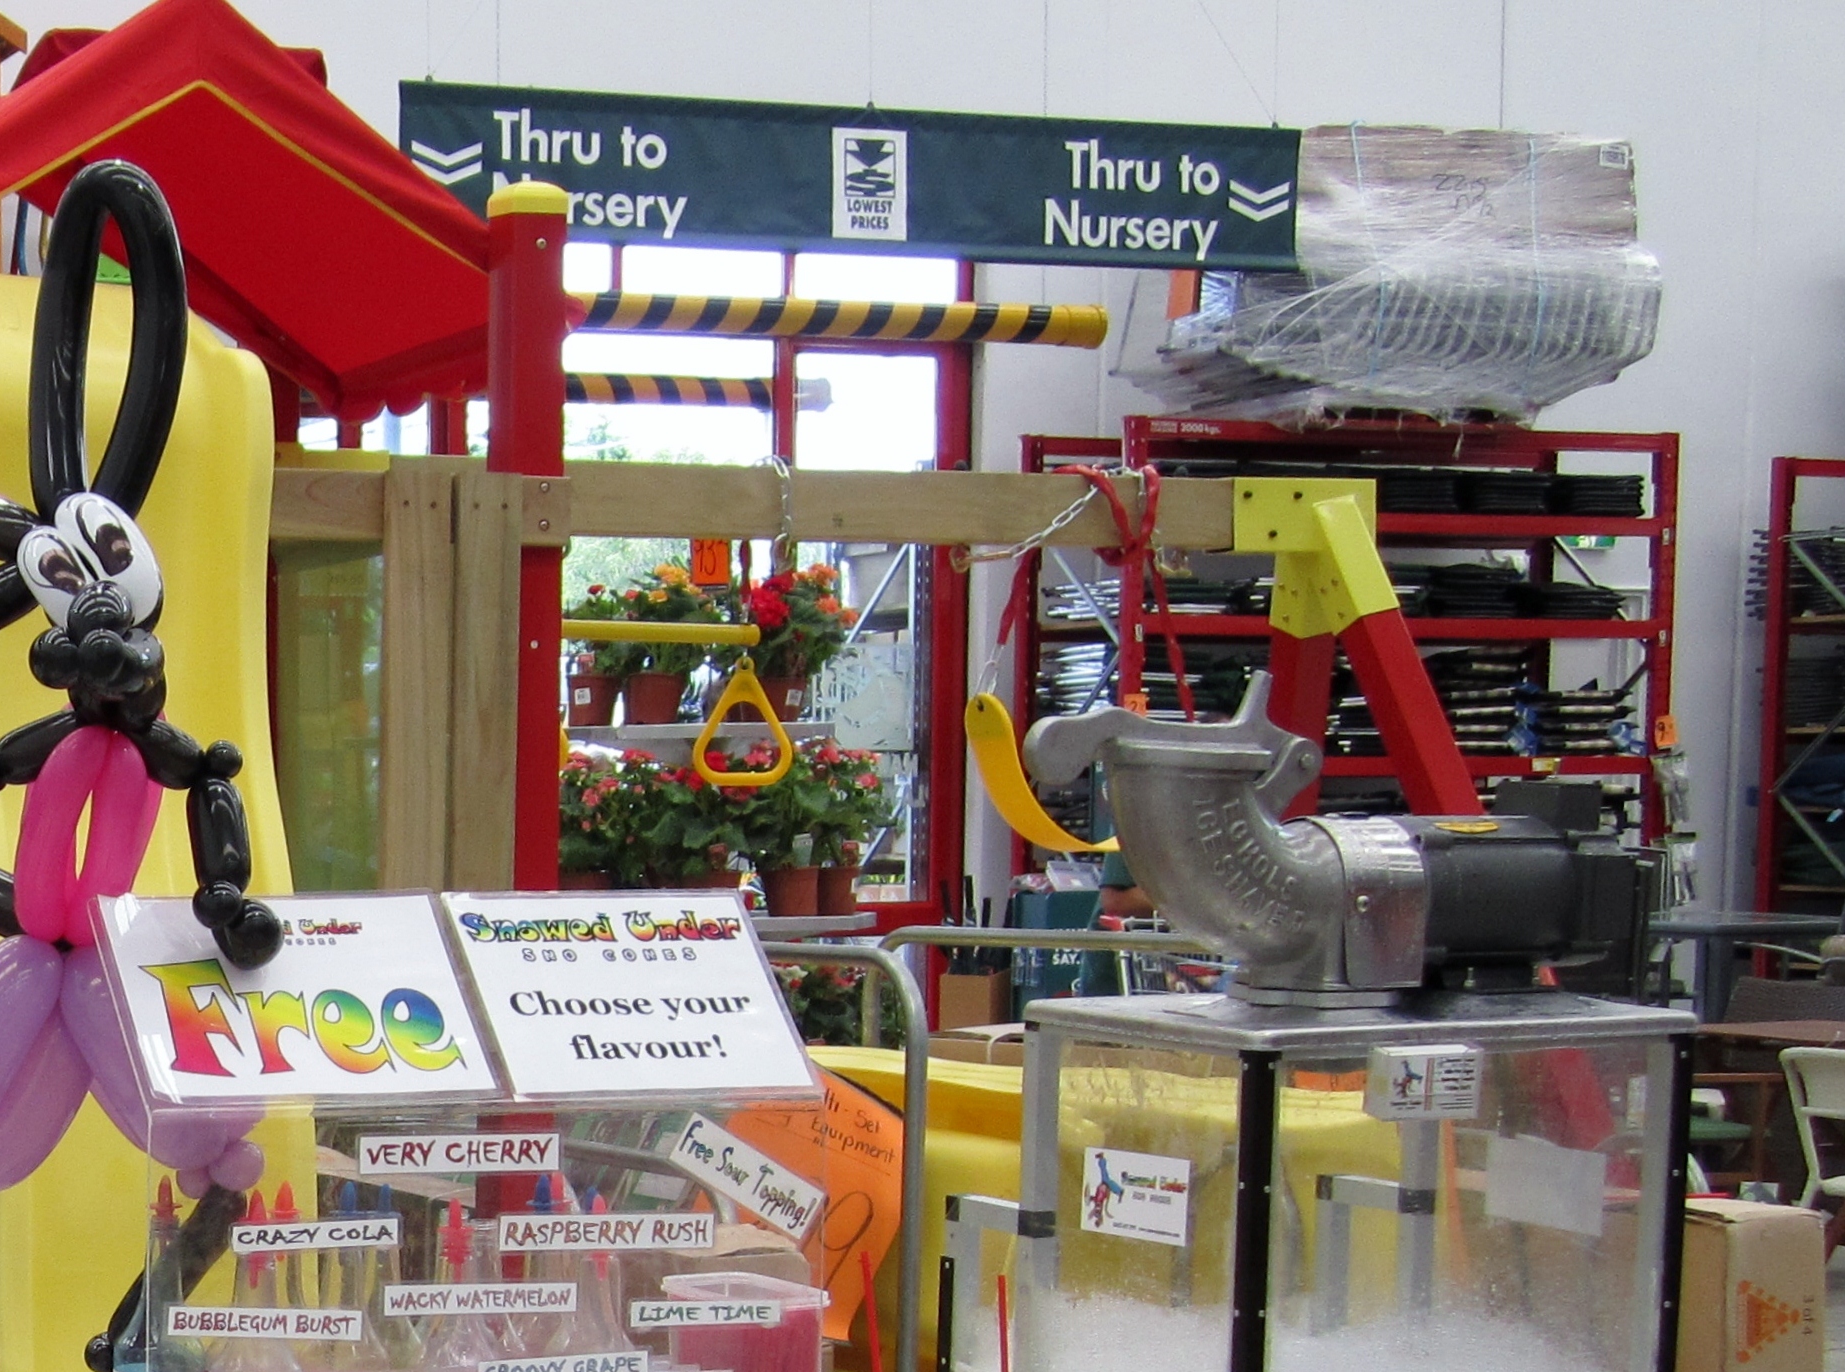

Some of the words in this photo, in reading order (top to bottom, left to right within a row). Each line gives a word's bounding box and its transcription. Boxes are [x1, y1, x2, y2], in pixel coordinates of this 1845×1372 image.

[493, 108, 601, 165] Thru
[620, 126, 668, 169] to
[1065, 140, 1160, 194] Thru
[1180, 155, 1221, 196] to
[847, 199, 893, 213] LOWEST
[851, 215, 889, 230] PRICES
[1044, 200, 1218, 261] Nursery
[298, 918, 363, 936] Under
[459, 911, 619, 943] Snowed
[623, 909, 742, 942] Under
[522, 947, 578, 962] SNO
[602, 947, 698, 962] CONES
[1052, 953, 1081, 966] SAY.
[509, 989, 654, 1017] Choose
[660, 995, 751, 1021] your
[138, 958, 469, 1079] Free
[568, 1032, 729, 1061] flavour!
[366, 1139, 433, 1167] VERY
[445, 1137, 553, 1165] CHERRY
[678, 1125, 716, 1165] Free
[752, 1162, 817, 1230] Topping!
[237, 1225, 319, 1246] CRAZY
[327, 1223, 395, 1243] COLA
[504, 1218, 644, 1244] RASPBERRY
[651, 1219, 710, 1242] RUSH
[389, 1290, 451, 1311] WACKY
[455, 1287, 571, 1309] WATERMELON
[172, 1312, 289, 1335] BUBBLEGUM
[294, 1315, 357, 1337] BURST
[637, 1304, 702, 1323] LIME
[712, 1302, 771, 1322] TIME
